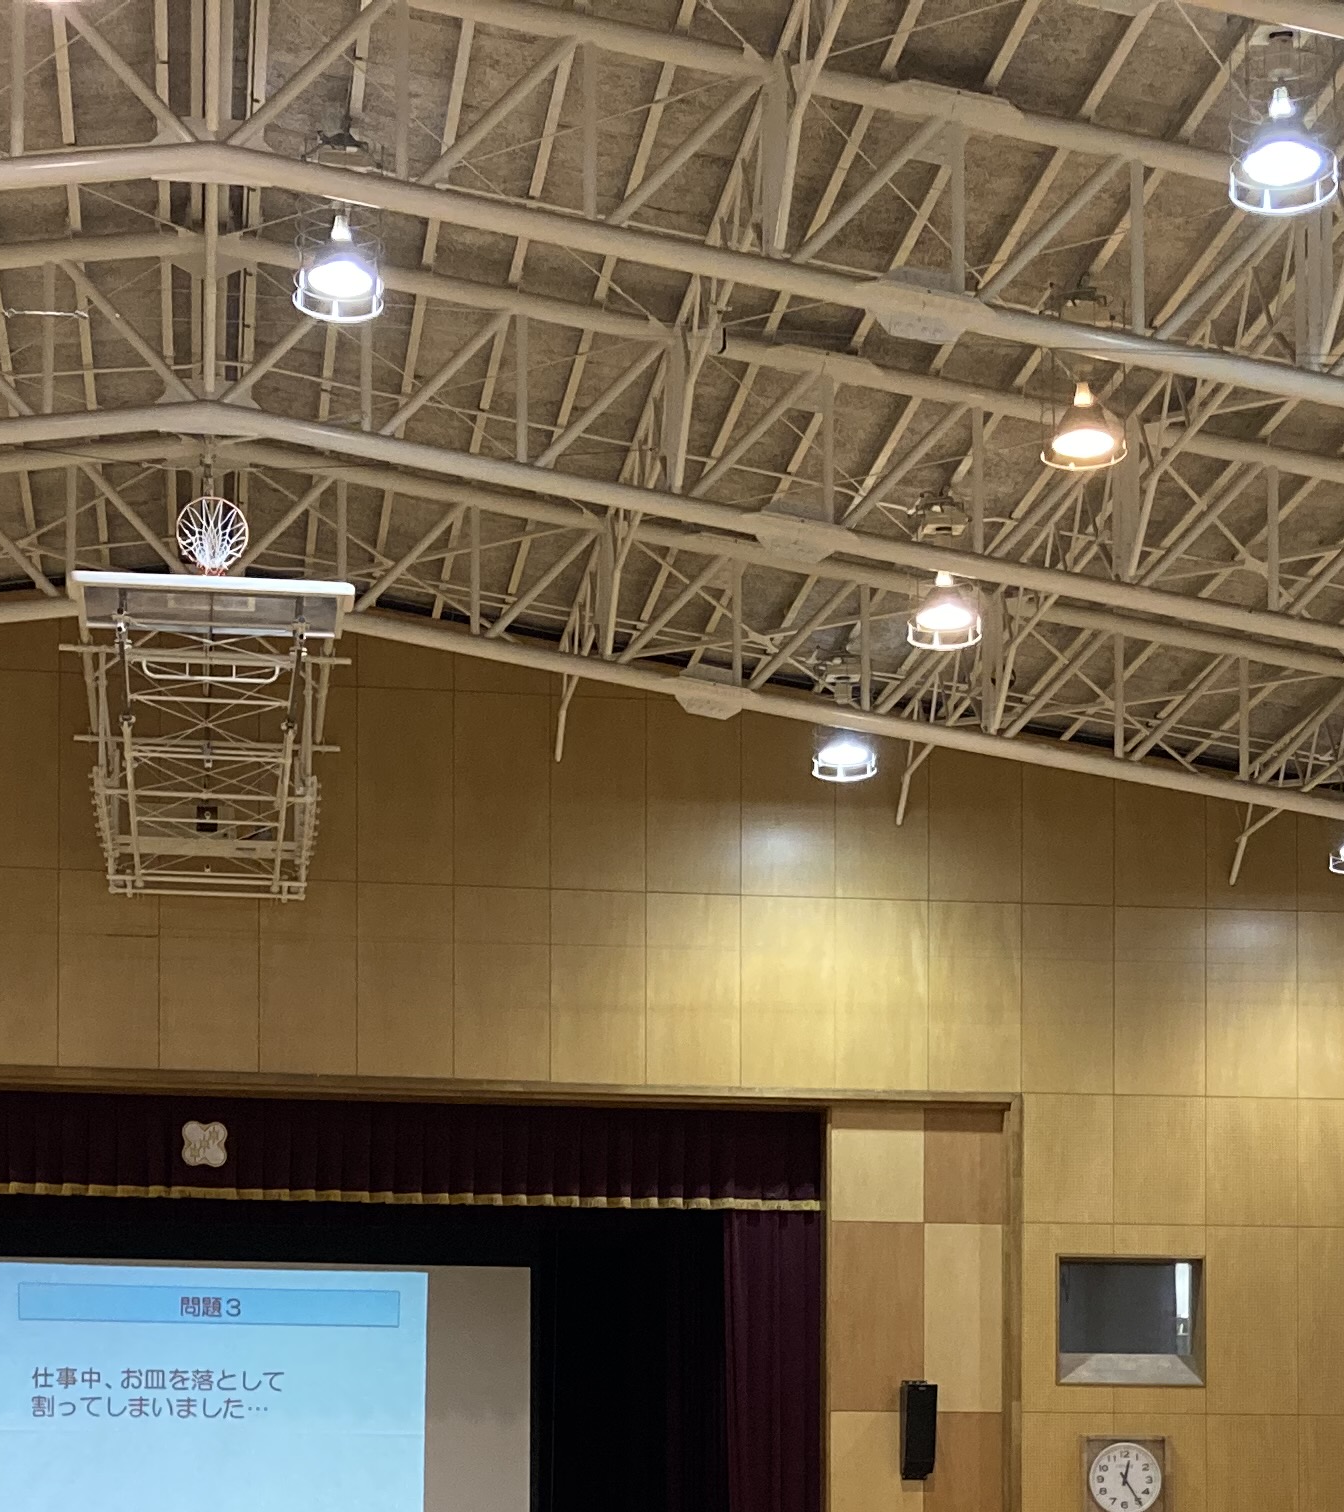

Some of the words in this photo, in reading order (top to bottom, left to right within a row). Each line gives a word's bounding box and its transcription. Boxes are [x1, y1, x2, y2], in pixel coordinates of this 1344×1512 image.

[180, 1296, 242, 1318] 問題3
[31, 1366, 285, 1392] 仕事中、お皿を落として
[1119, 1450, 1130, 1458] 12
[1098, 1464, 1109, 1472] 10
[1141, 1463, 1150, 1471] 2
[1096, 1475, 1105, 1483] 9
[1145, 1476, 1153, 1484] 3
[1099, 1487, 1107, 1496] 8
[1109, 1497, 1117, 1505] 7
[1120, 1501, 1129, 1509] 6
